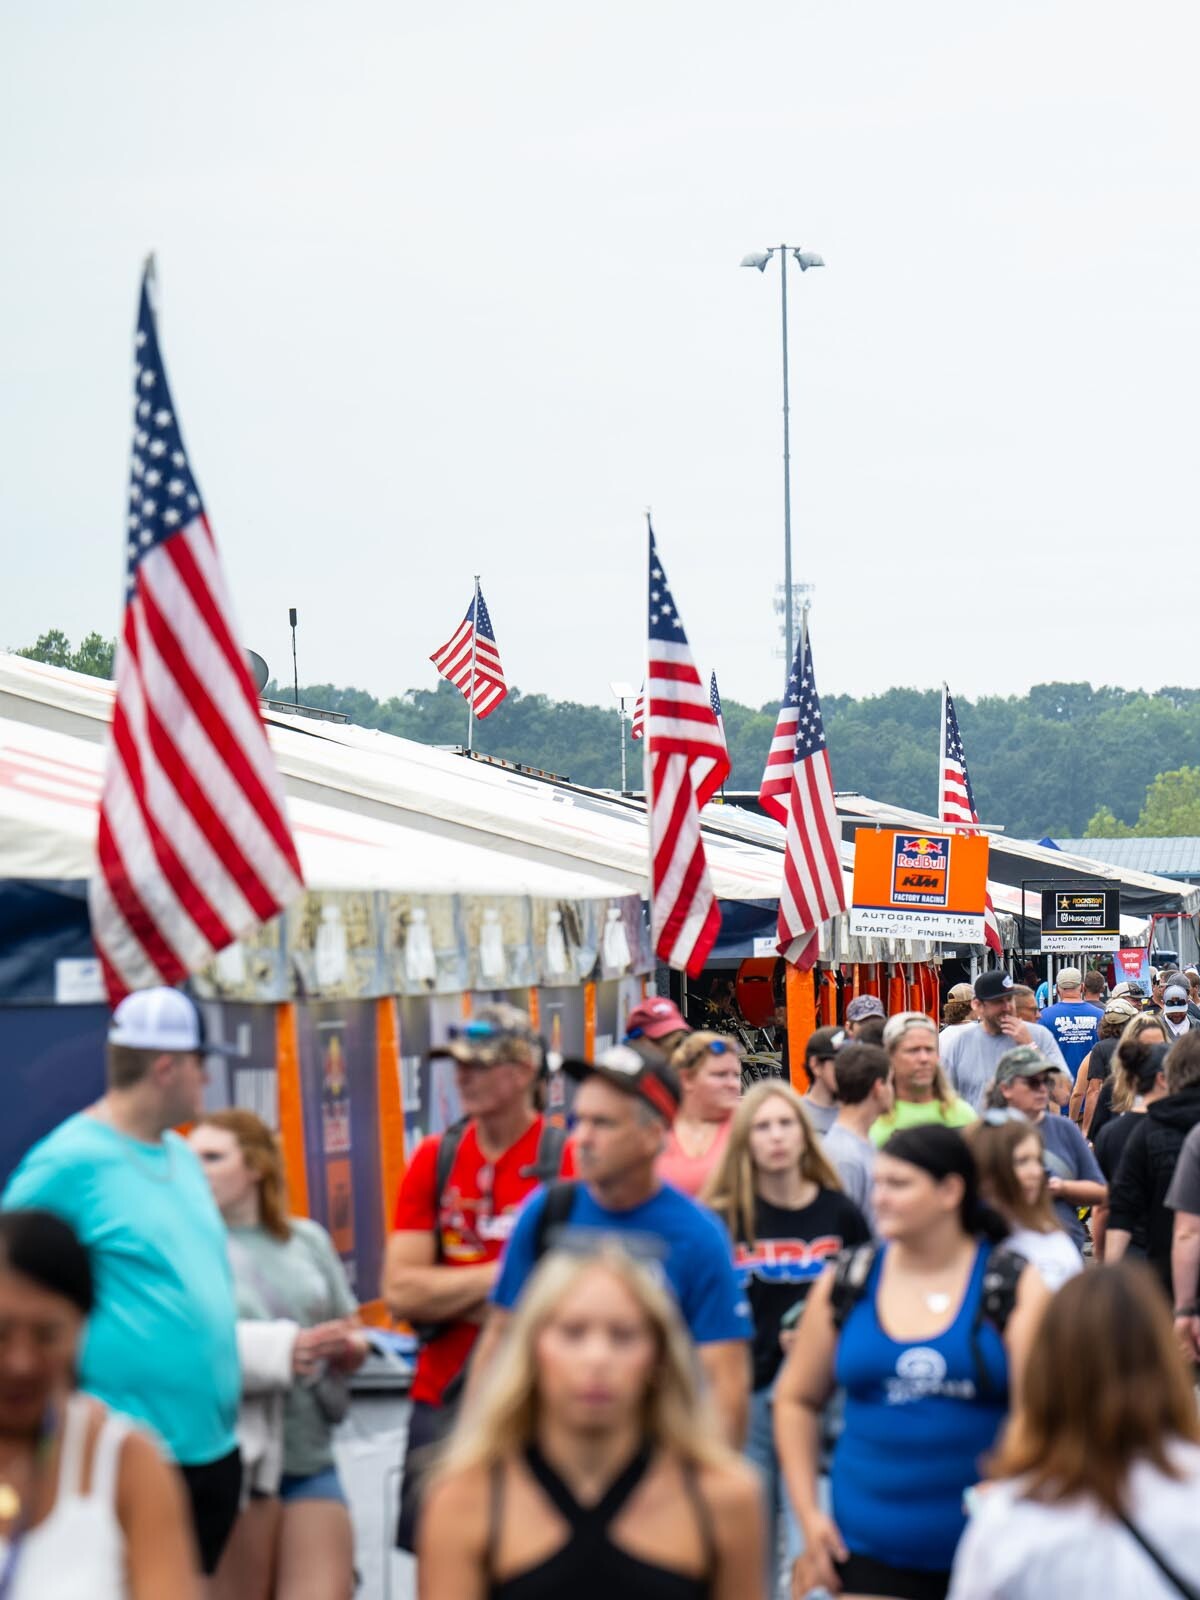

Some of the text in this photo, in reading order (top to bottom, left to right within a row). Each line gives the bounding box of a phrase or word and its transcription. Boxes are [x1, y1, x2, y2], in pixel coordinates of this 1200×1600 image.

[897, 853, 947, 870] Red Bull
[902, 874, 940, 888] KTM
[894, 893, 945, 904] FACTORY RACING
[861, 911, 975, 926] AUTOGRAPH TIME
